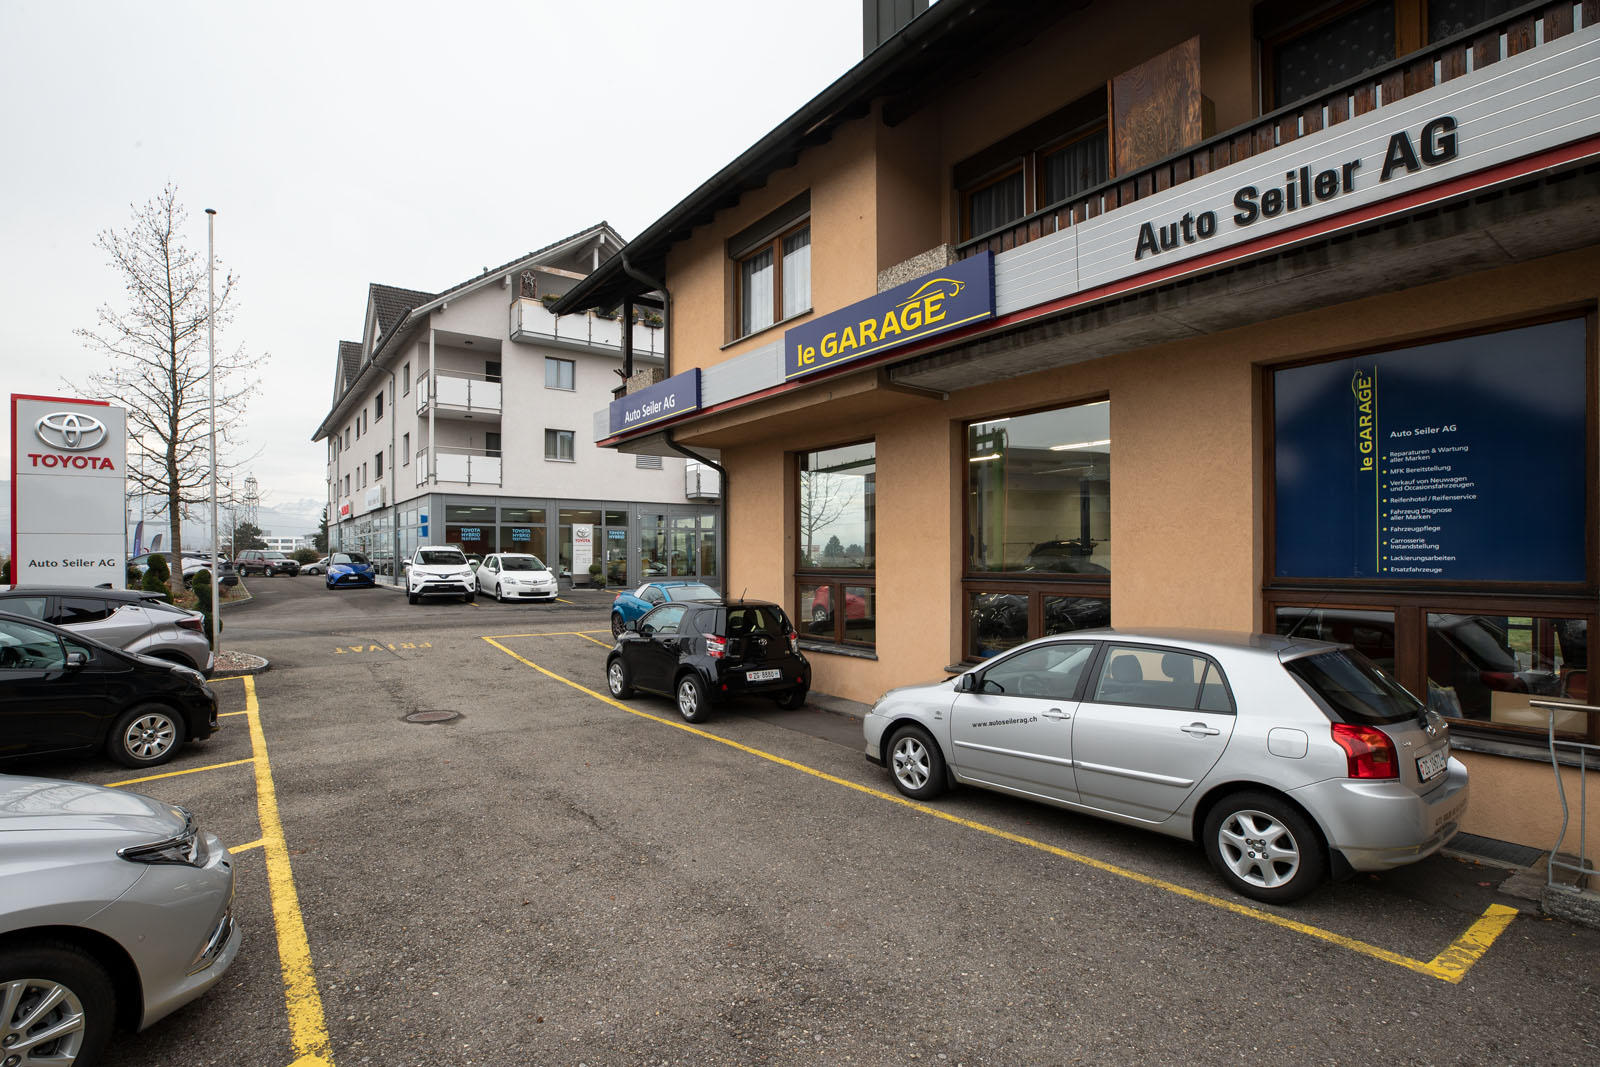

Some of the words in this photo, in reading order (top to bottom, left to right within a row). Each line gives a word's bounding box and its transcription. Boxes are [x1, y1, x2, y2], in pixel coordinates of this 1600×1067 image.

[1133, 210, 1218, 261] Auto
[1233, 157, 1362, 227] Seiler
[1379, 115, 1459, 183] AG
[797, 343, 815, 368] le
[820, 291, 947, 359] GARAGE
[624, 409, 641, 424] Auto
[642, 400, 662, 418] Seiler
[663, 393, 676, 410] AG
[1359, 376, 1373, 454] GARAGE
[1414, 426, 1440, 436] Seiler
[1442, 424, 1457, 432] AG
[1390, 448, 1430, 458] Reparaturen
[1438, 445, 1469, 453] Wartung
[28, 454, 115, 470] TOYOTA
[1360, 457, 1373, 471] le
[1406, 464, 1452, 474] Bereitstellung
[1404, 481, 1475, 491] Occasionsfahrzeugen
[28, 559, 58, 568] Auto
[62, 559, 95, 567] Seiler
[98, 558, 116, 567] AG
[972, 716, 1038, 728] www.autoseilerag.ch
